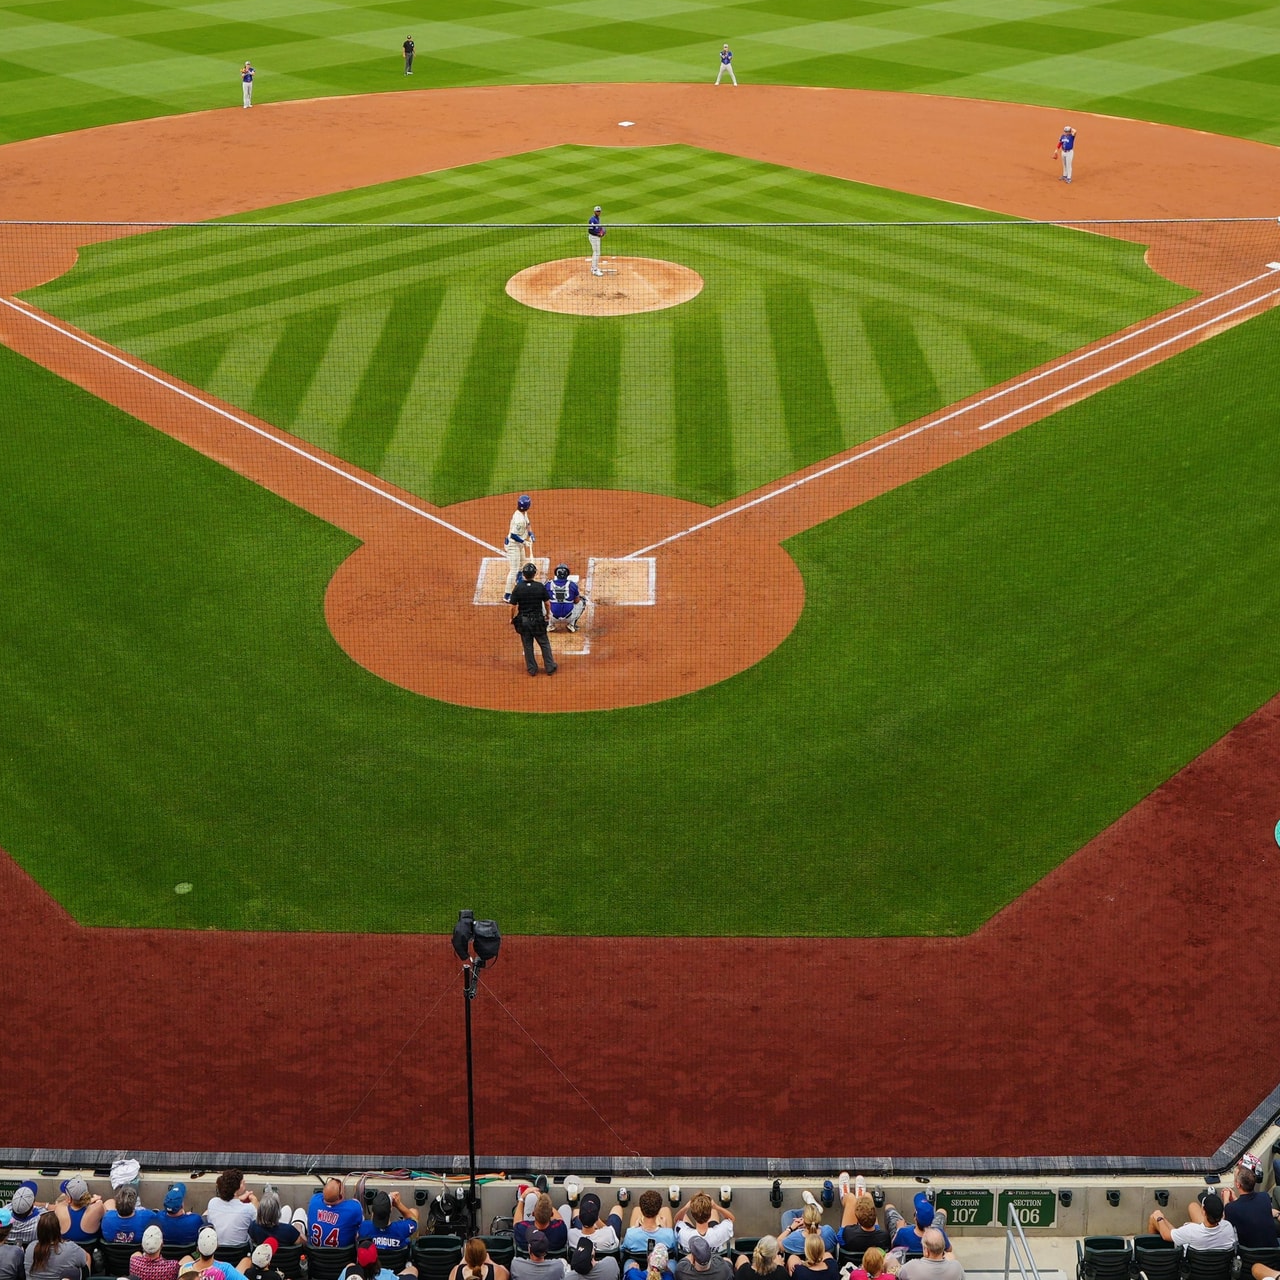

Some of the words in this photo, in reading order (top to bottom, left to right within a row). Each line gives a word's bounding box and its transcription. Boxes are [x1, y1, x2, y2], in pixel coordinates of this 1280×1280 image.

[951, 1199, 980, 1207] SECTION
[1013, 1199, 1042, 1207] SECTION
[317, 1209, 339, 1225] WOOD
[952, 1208, 978, 1223] 107
[311, 1223, 340, 1247] 34
